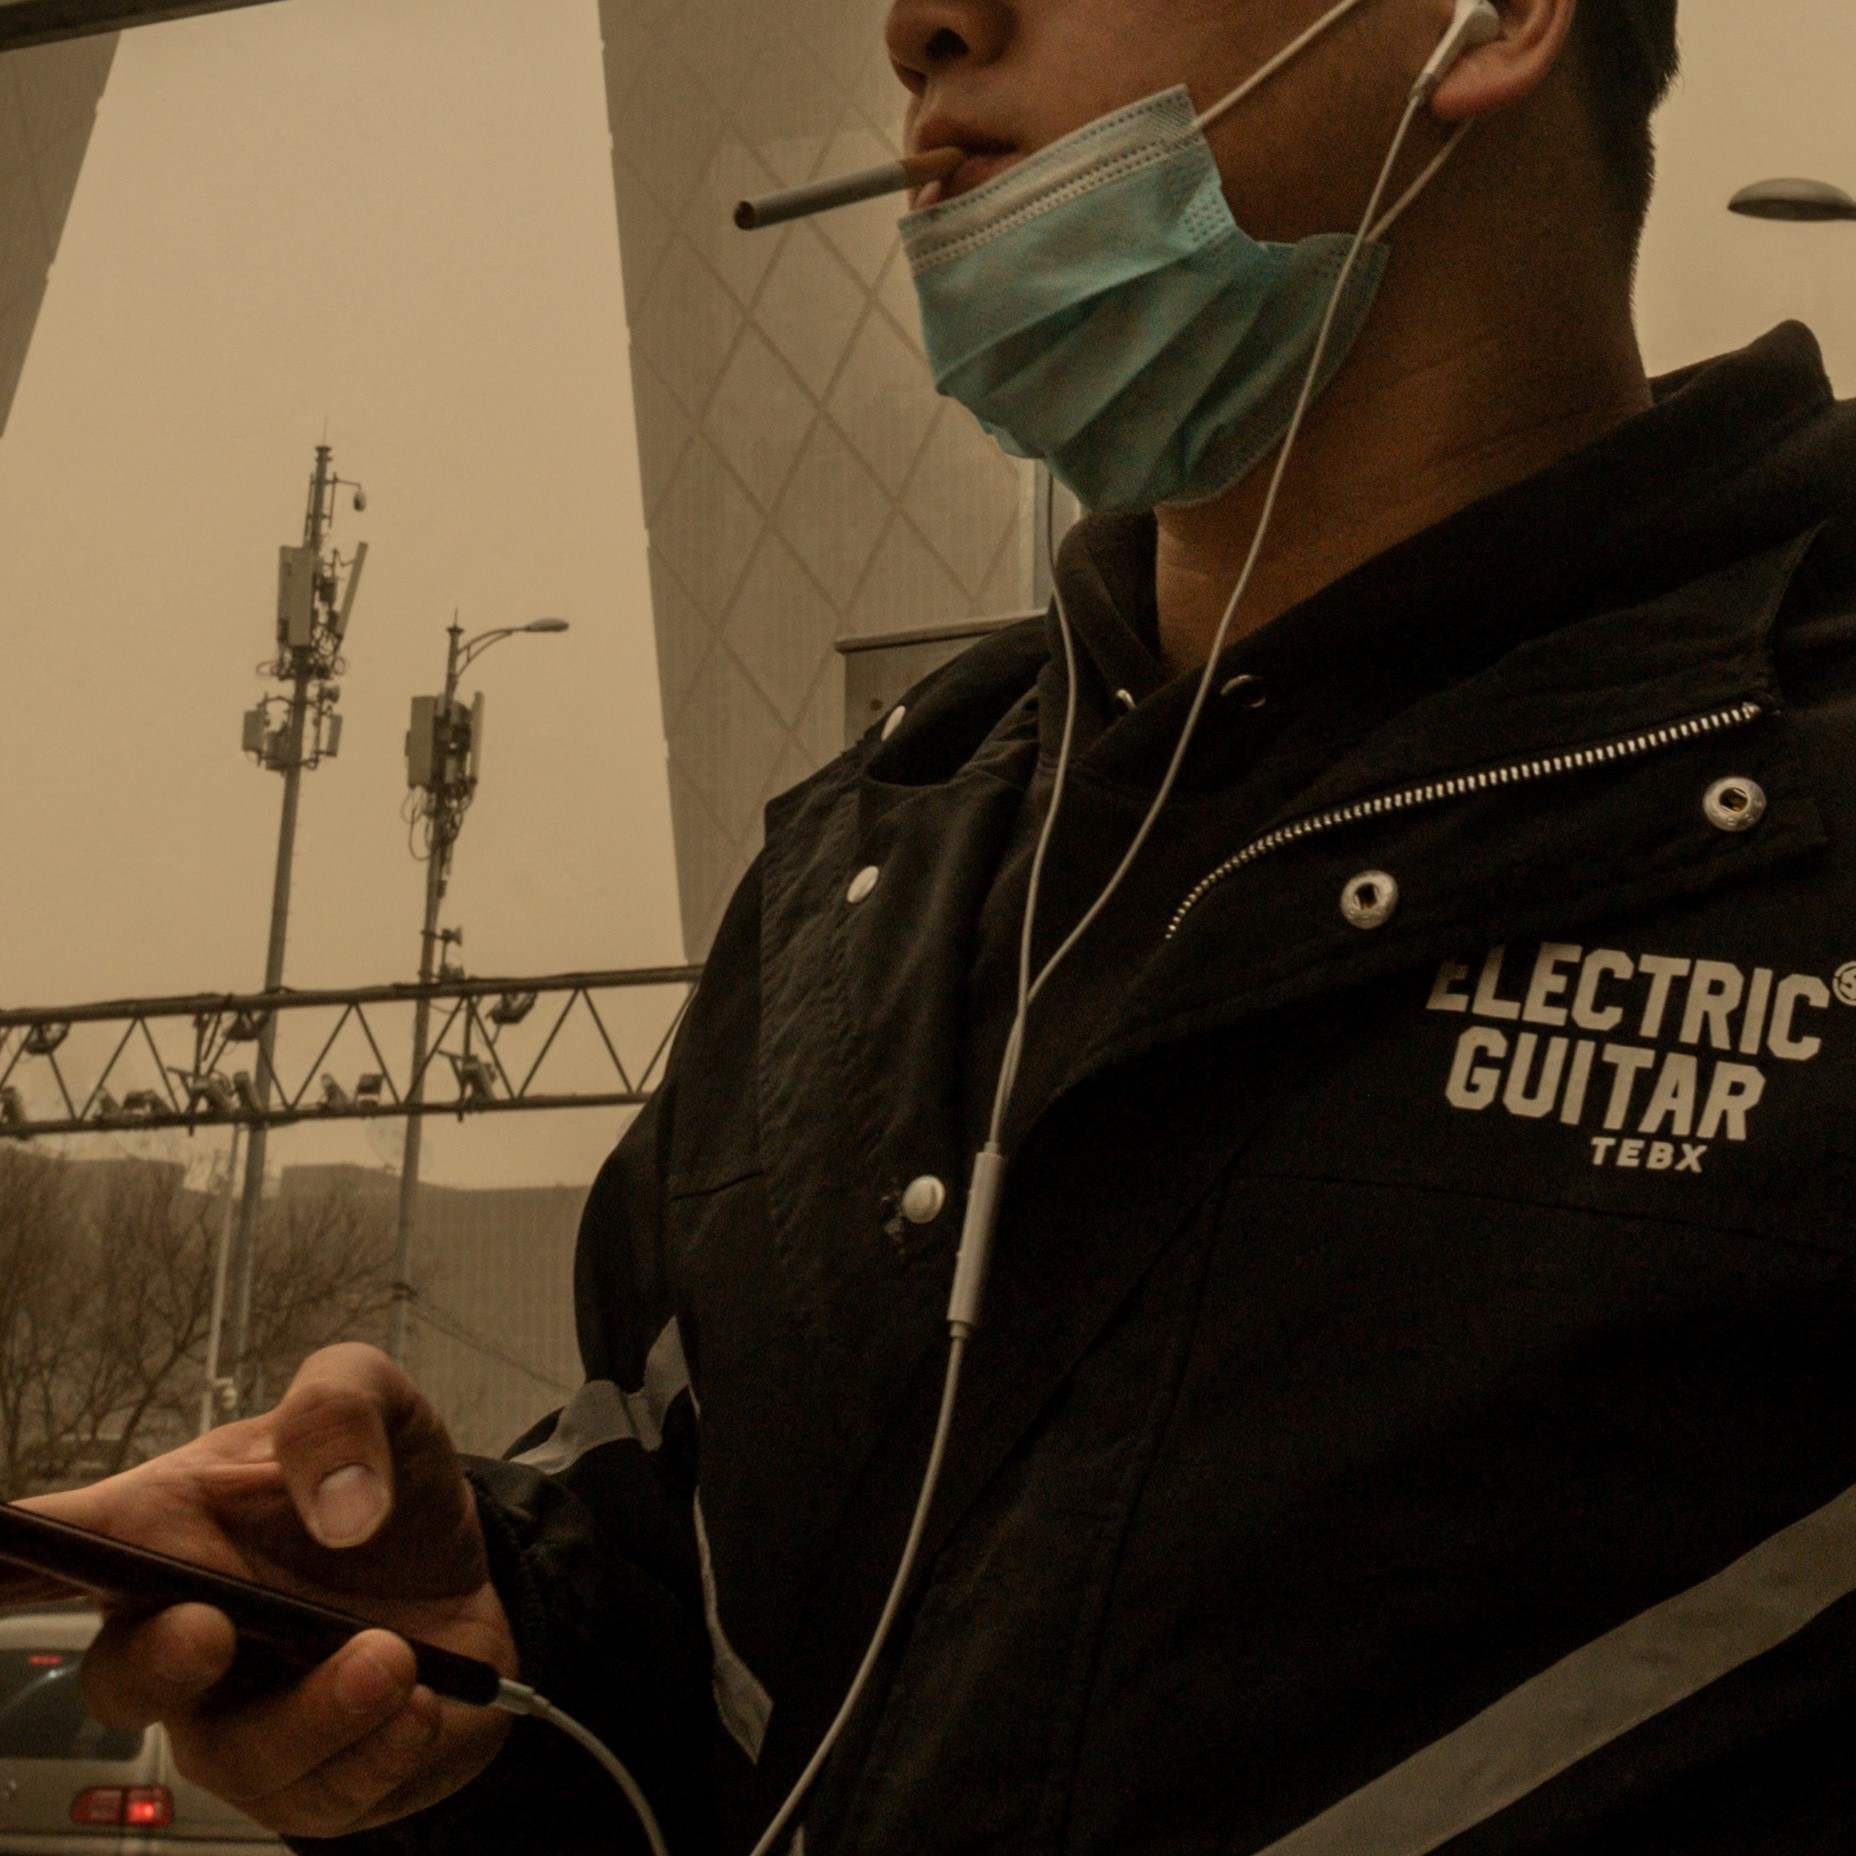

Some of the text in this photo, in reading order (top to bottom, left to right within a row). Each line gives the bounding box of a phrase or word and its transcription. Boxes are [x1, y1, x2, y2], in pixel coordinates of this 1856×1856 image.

[1426, 943, 1831, 1062] ELECTRIC
[1445, 1025, 1767, 1142] GUITAR
[1590, 1136, 1708, 1174] TEBX
